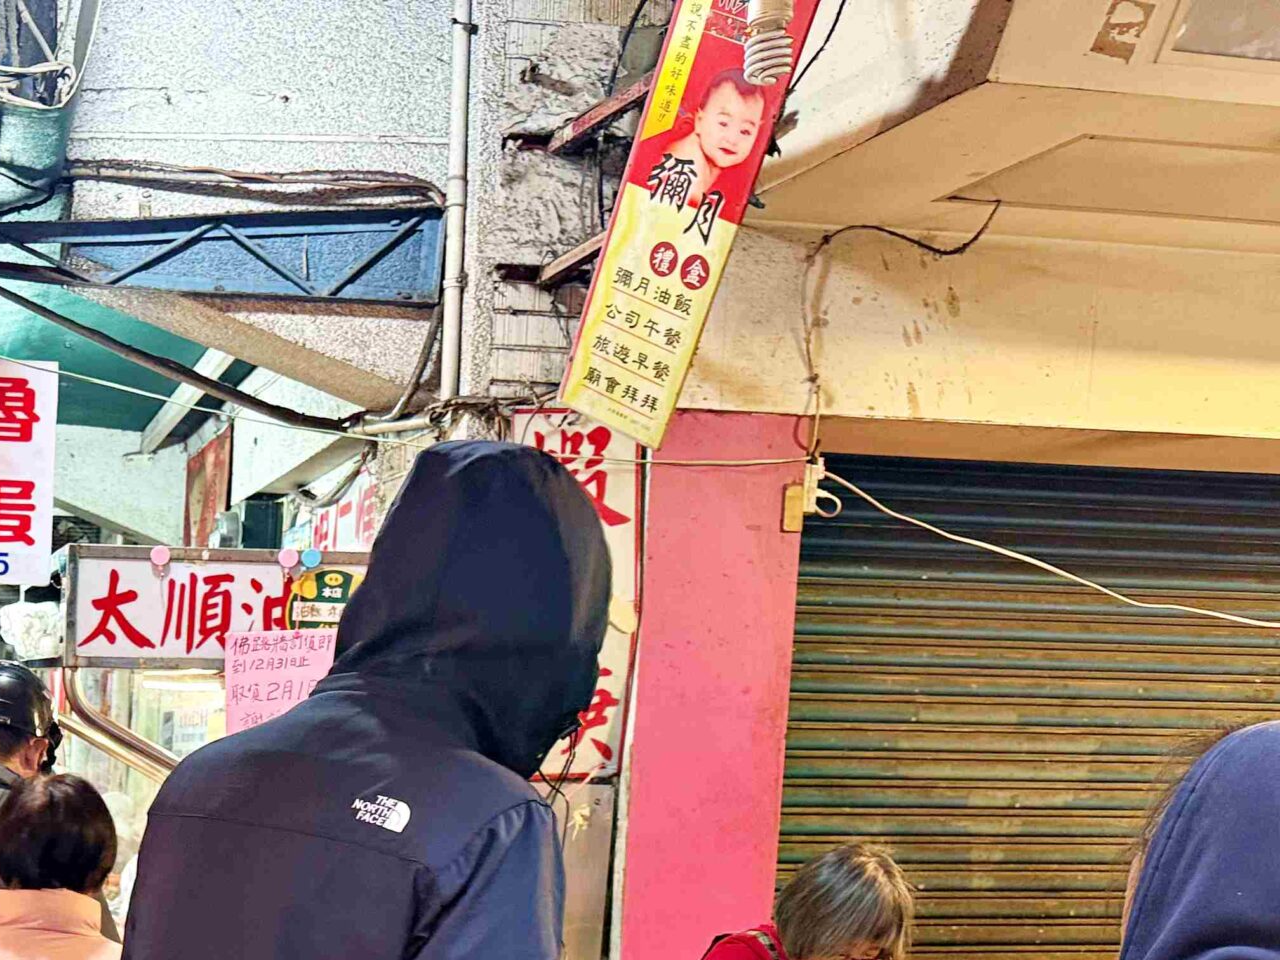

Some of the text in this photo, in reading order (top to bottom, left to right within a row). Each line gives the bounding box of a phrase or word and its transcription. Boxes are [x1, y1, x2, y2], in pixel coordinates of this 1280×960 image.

[646, 153, 724, 246] 彌月
[654, 244, 708, 288] 禮盒
[613, 266, 691, 317] 彌月油飯
[605, 303, 682, 350] 公司午餐
[593, 335, 670, 382] 旅遊早餐
[583, 366, 658, 413] 廟會拜拜
[351, 798, 392, 818] NORTH
[355, 810, 388, 827] FACE
[375, 794, 398, 809] THE
